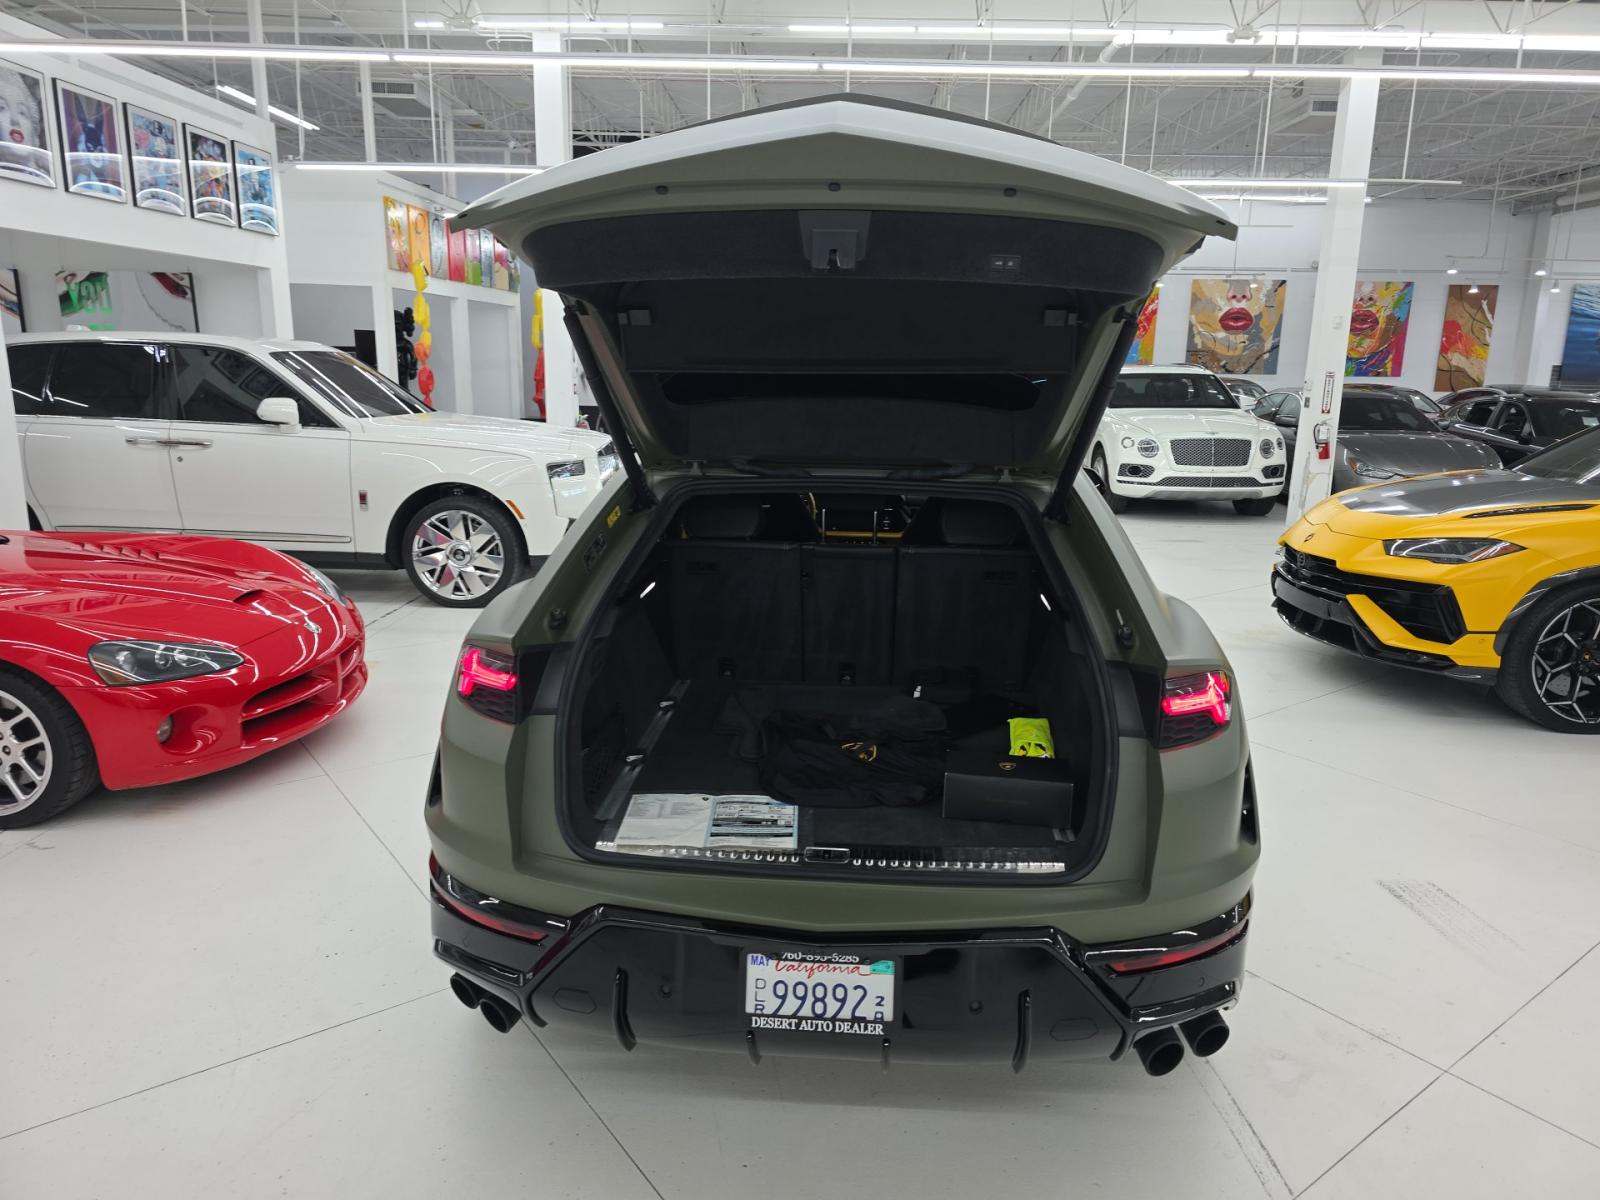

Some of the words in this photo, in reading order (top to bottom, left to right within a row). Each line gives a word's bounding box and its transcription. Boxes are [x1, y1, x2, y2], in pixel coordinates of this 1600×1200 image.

[750, 954, 771, 967] MAY
[771, 979, 867, 1021] 99892
[751, 1016, 799, 1031] DESERT
[799, 1019, 833, 1033] AUTO
[834, 1021, 885, 1036] DEALER
